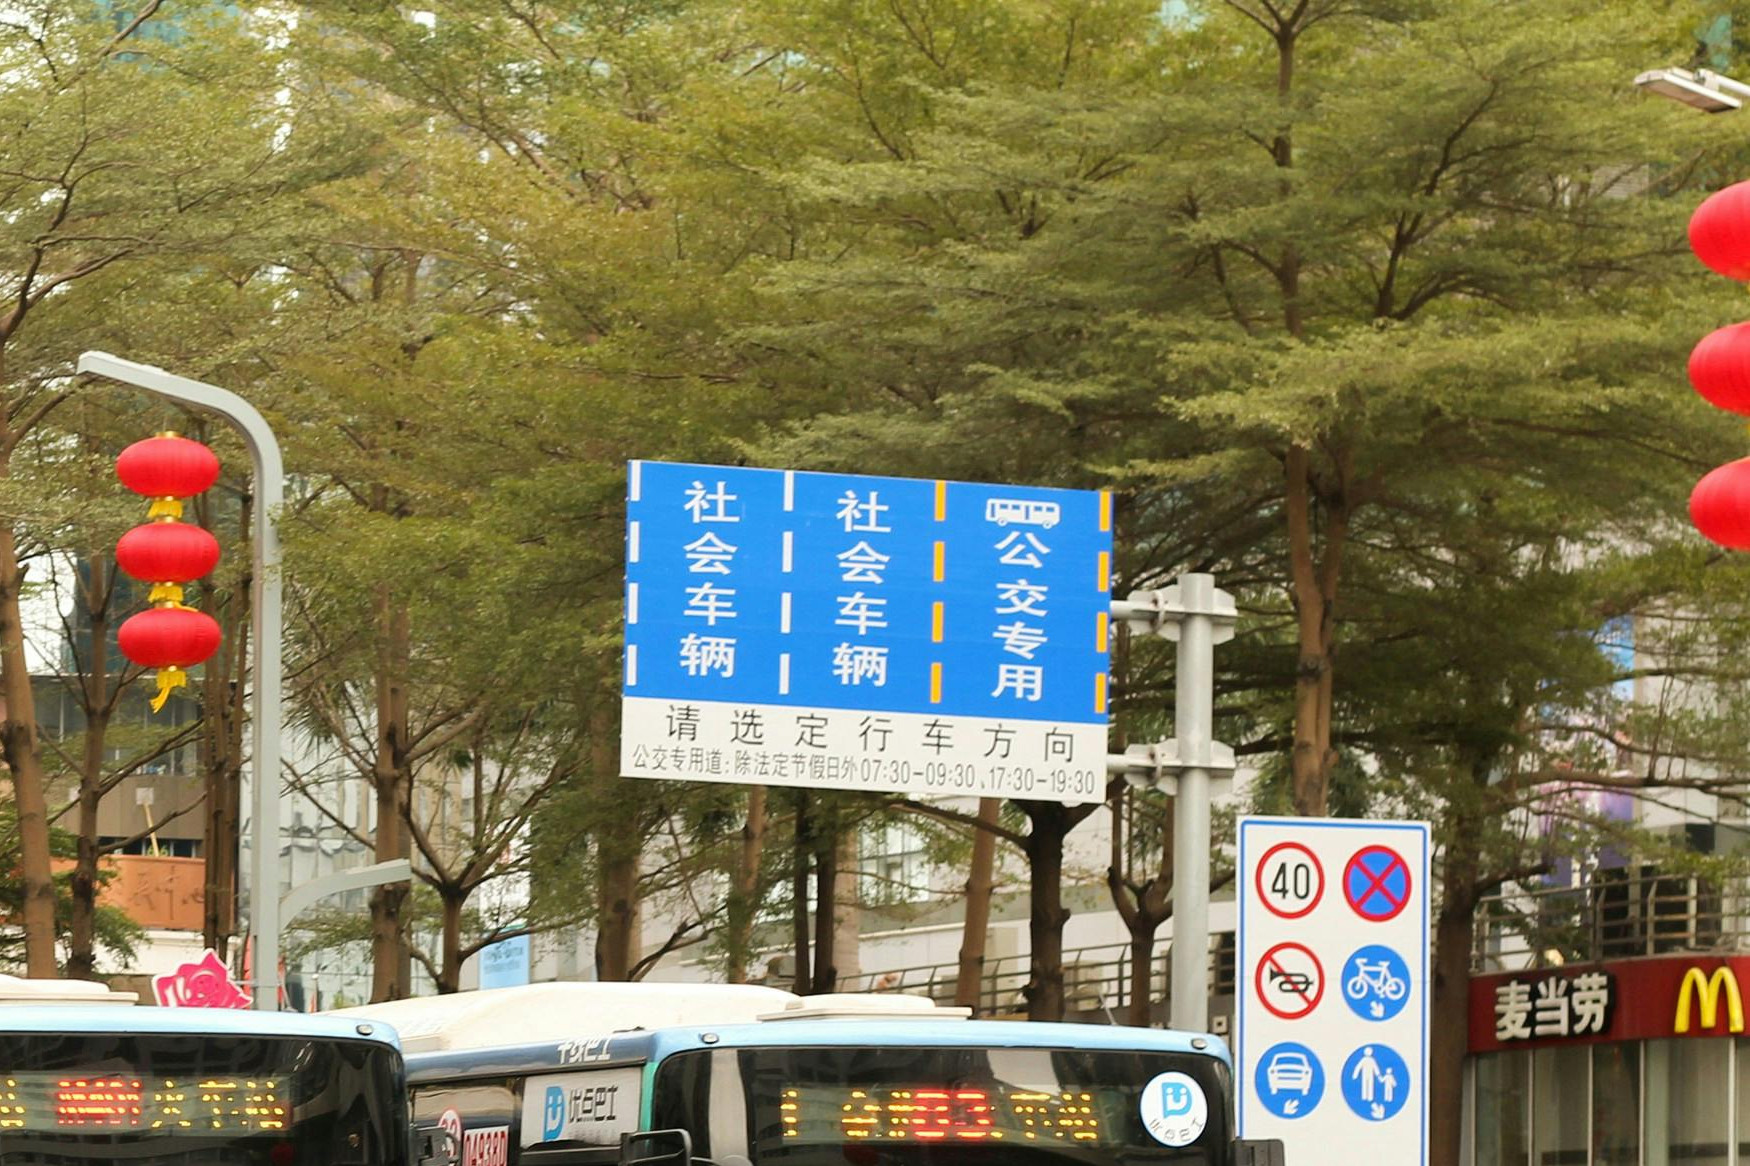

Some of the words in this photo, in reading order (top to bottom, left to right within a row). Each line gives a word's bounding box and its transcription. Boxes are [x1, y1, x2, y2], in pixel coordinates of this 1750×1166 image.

[680, 480, 740, 678] 社会车辆
[833, 490, 891, 687] 社会车辆
[991, 530, 1051, 701] 公交专用
[665, 704, 1075, 763] 请选定行车方向
[1271, 862, 1310, 900] 40
[1494, 973, 1608, 1041] 麦当劳
